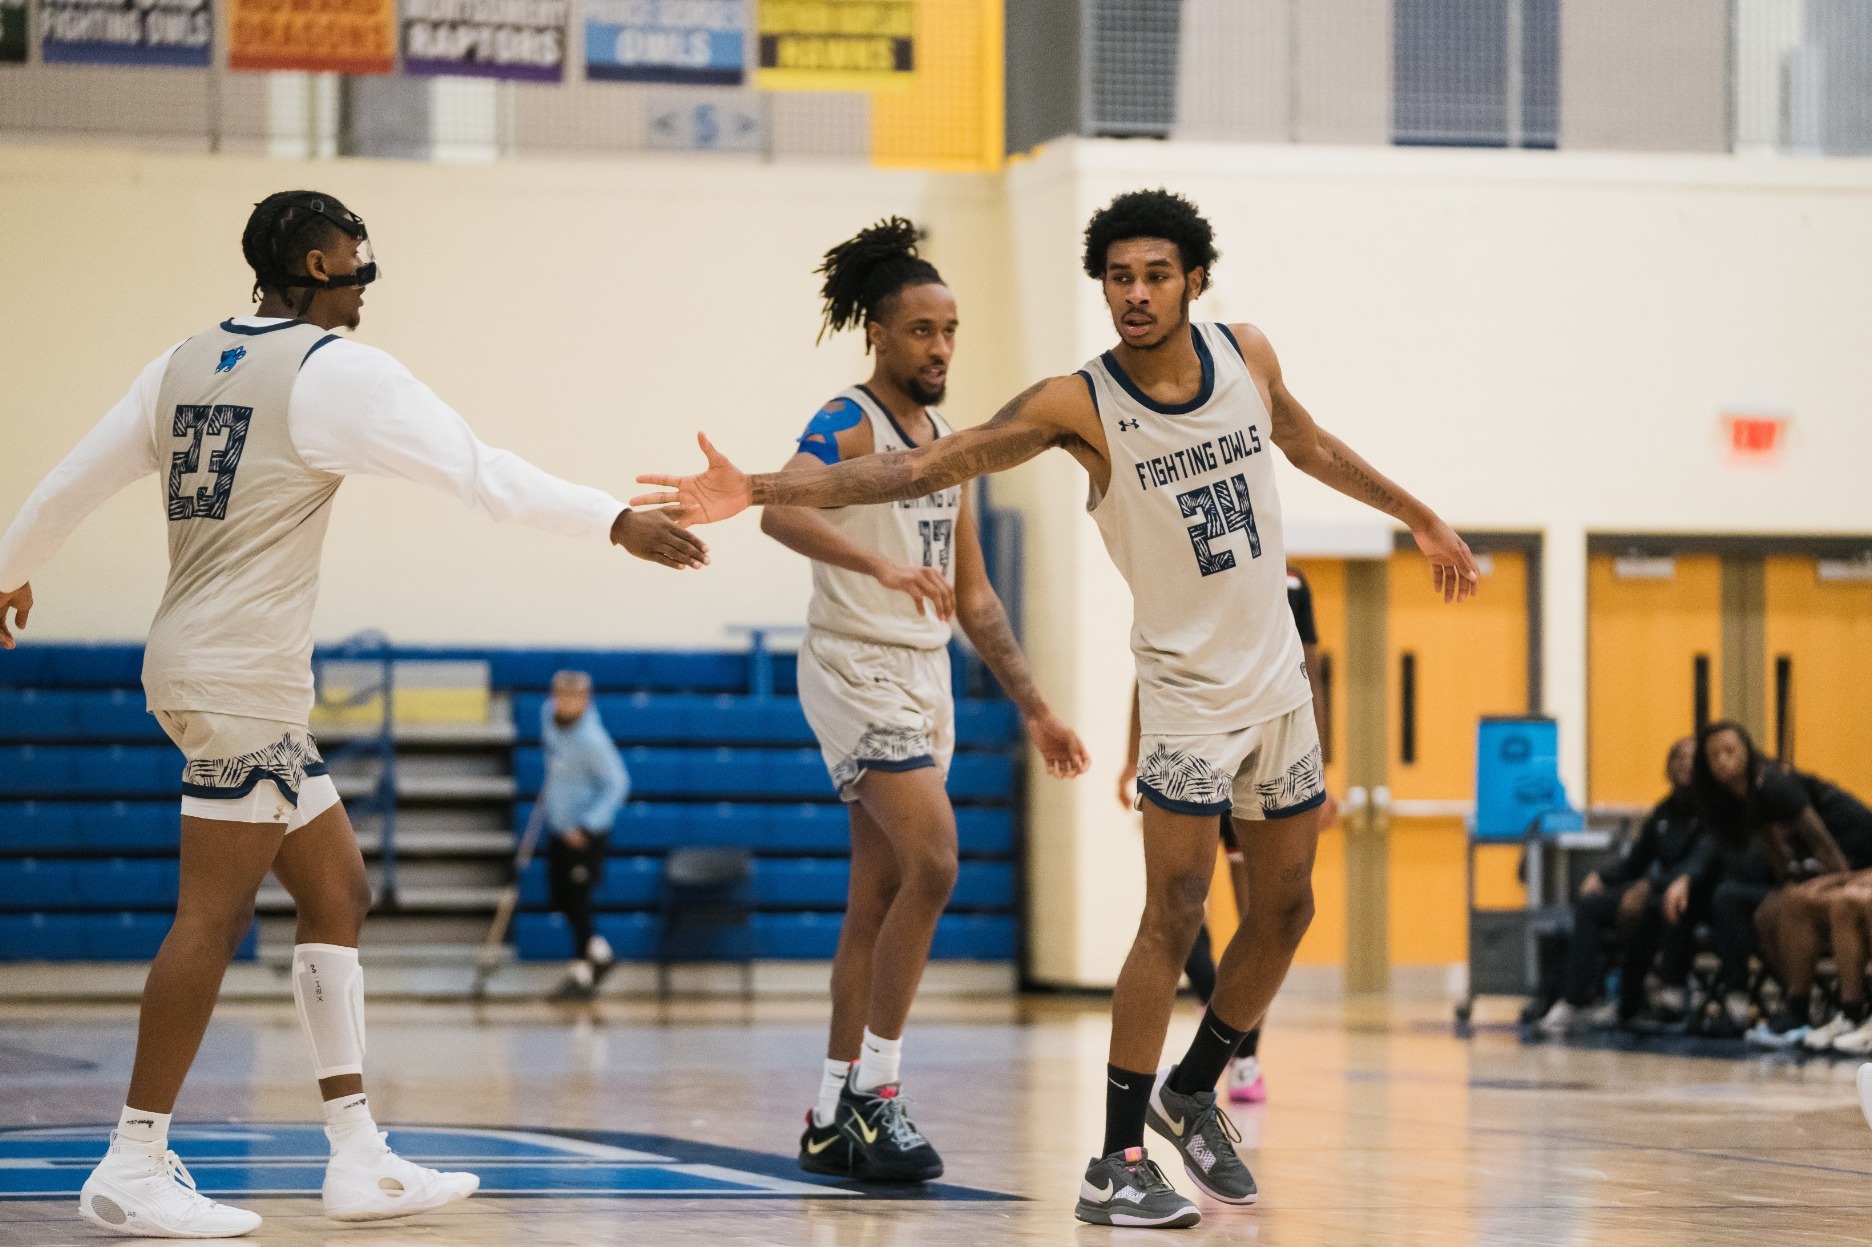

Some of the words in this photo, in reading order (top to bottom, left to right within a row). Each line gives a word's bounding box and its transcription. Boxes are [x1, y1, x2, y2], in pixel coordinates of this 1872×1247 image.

[408, 22, 561, 66] RAPTORS
[615, 28, 710, 67] OWLS
[168, 404, 254, 521] 23
[1135, 441, 1218, 490] FIGHTING
[1217, 424, 1262, 465] OWLS
[1175, 472, 1262, 577] 24
